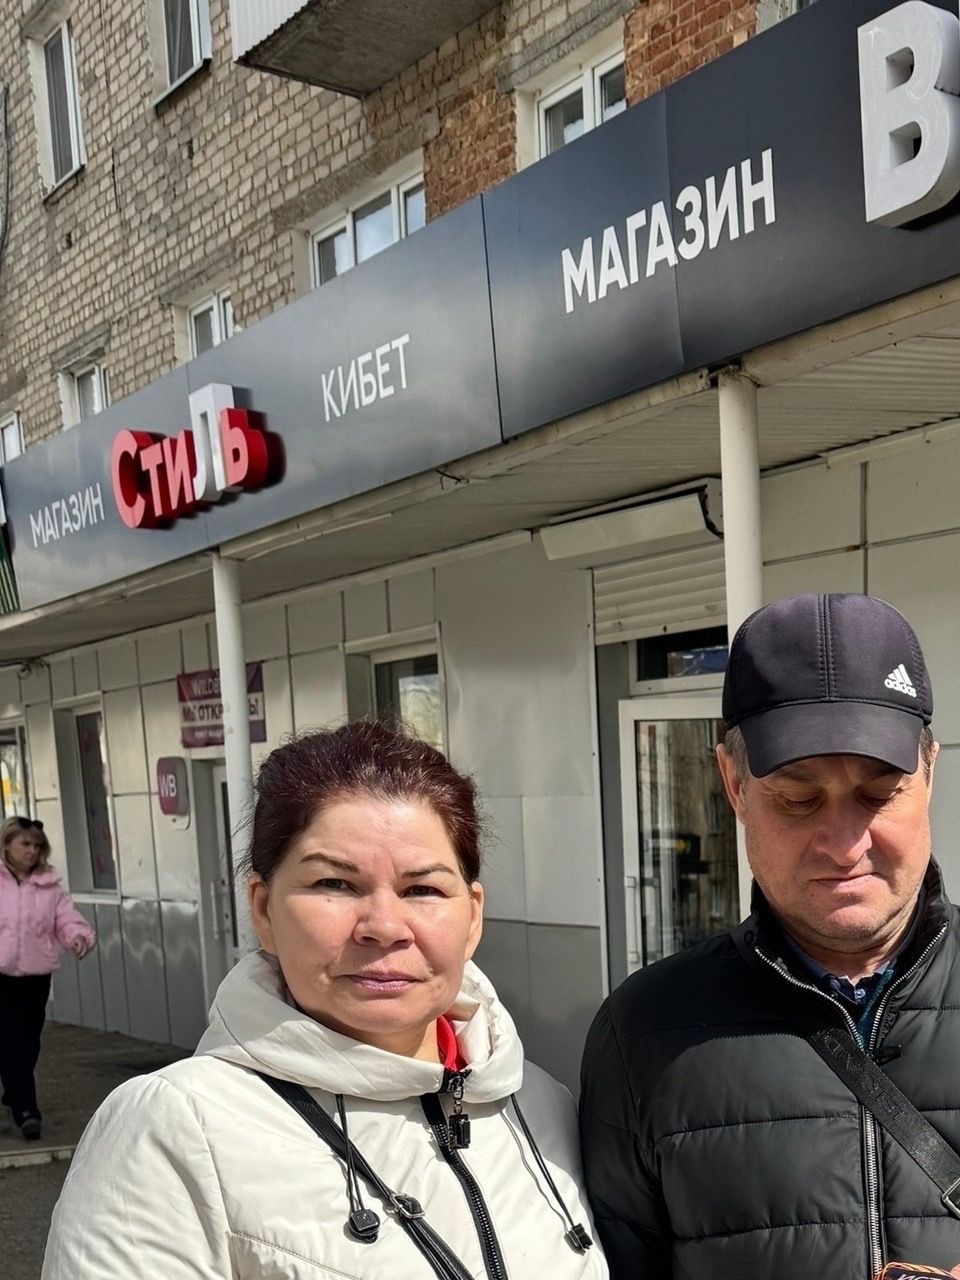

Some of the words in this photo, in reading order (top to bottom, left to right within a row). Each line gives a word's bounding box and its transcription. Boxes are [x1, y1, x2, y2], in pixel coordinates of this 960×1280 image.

[561, 148, 778, 314] МАГАЗИН
[29, 483, 106, 548] МАГАЗИН
[321, 333, 410, 422] КИБЕТ
[159, 773, 177, 797] WB
